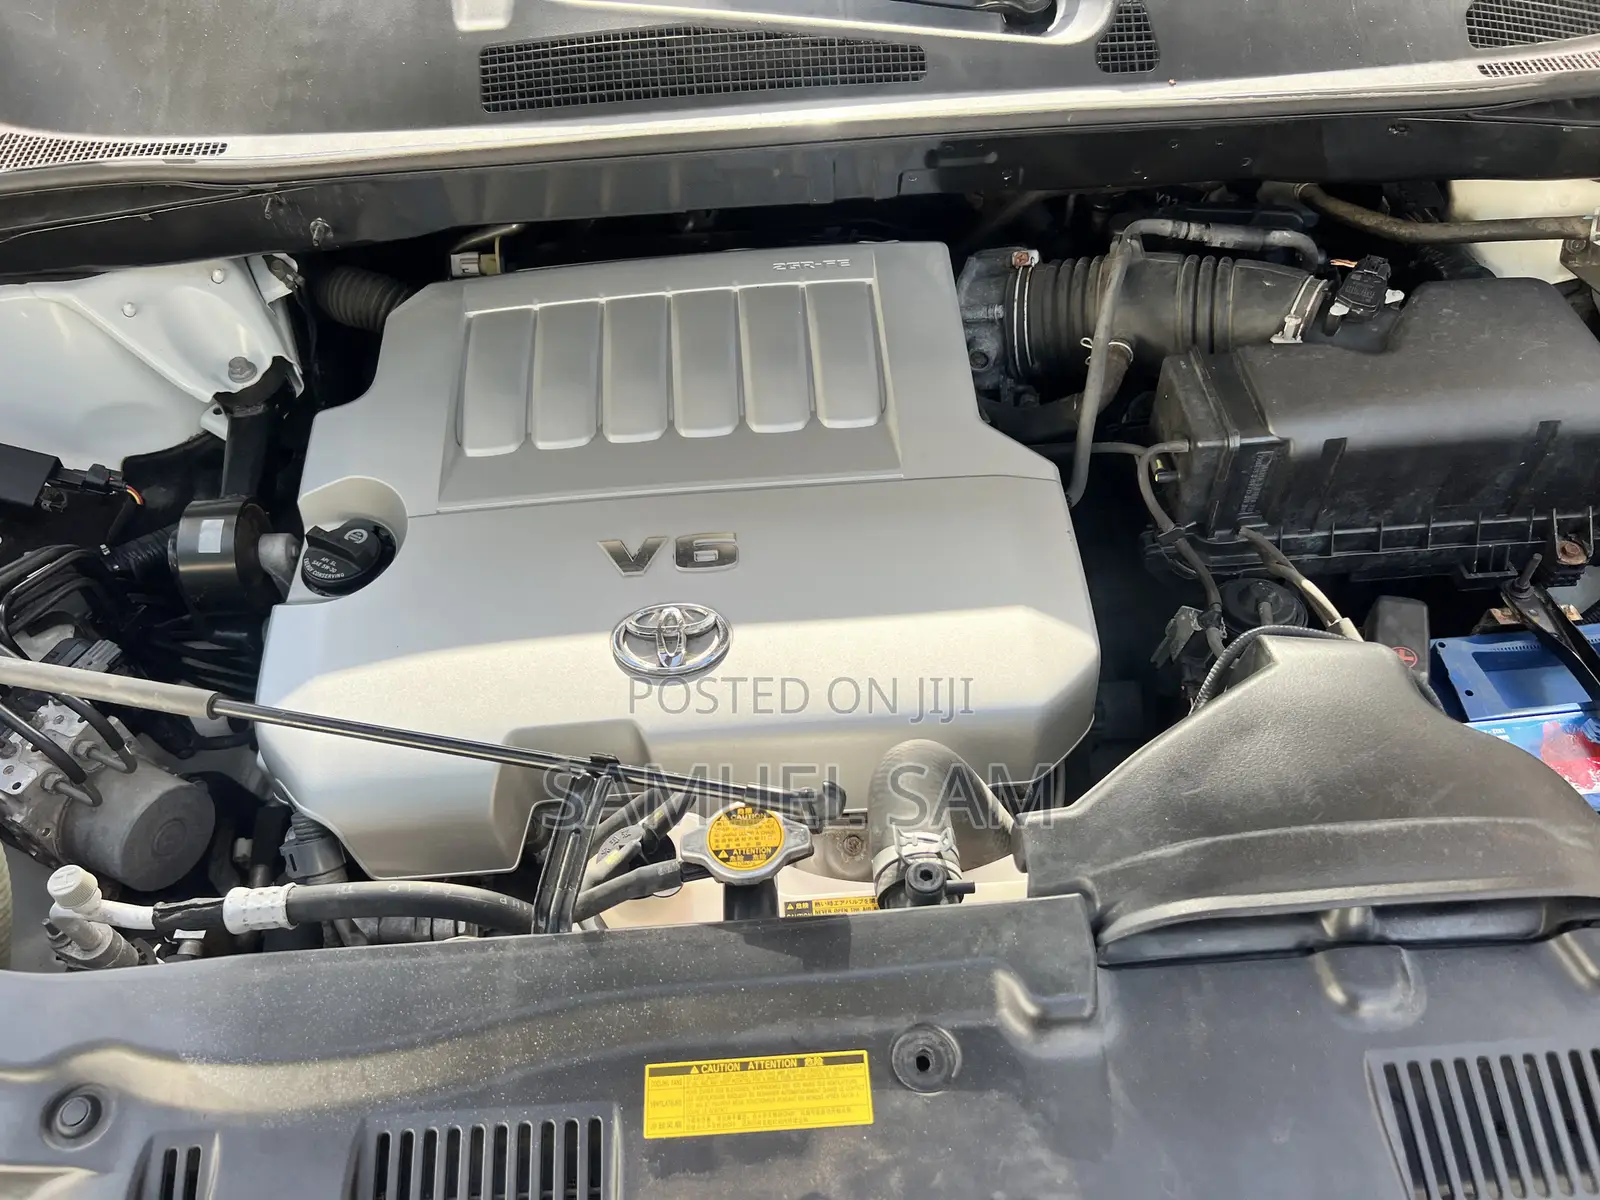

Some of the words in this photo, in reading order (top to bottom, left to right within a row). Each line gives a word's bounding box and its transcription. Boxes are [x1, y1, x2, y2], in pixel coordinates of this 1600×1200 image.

[596, 532, 740, 577] V6
[312, 571, 344, 579] CONSERVING
[730, 813, 767, 821] CAUTION
[732, 847, 773, 856] ATTENTION
[700, 1062, 741, 1074] CAUTION
[747, 1058, 798, 1071] ATTENTION
